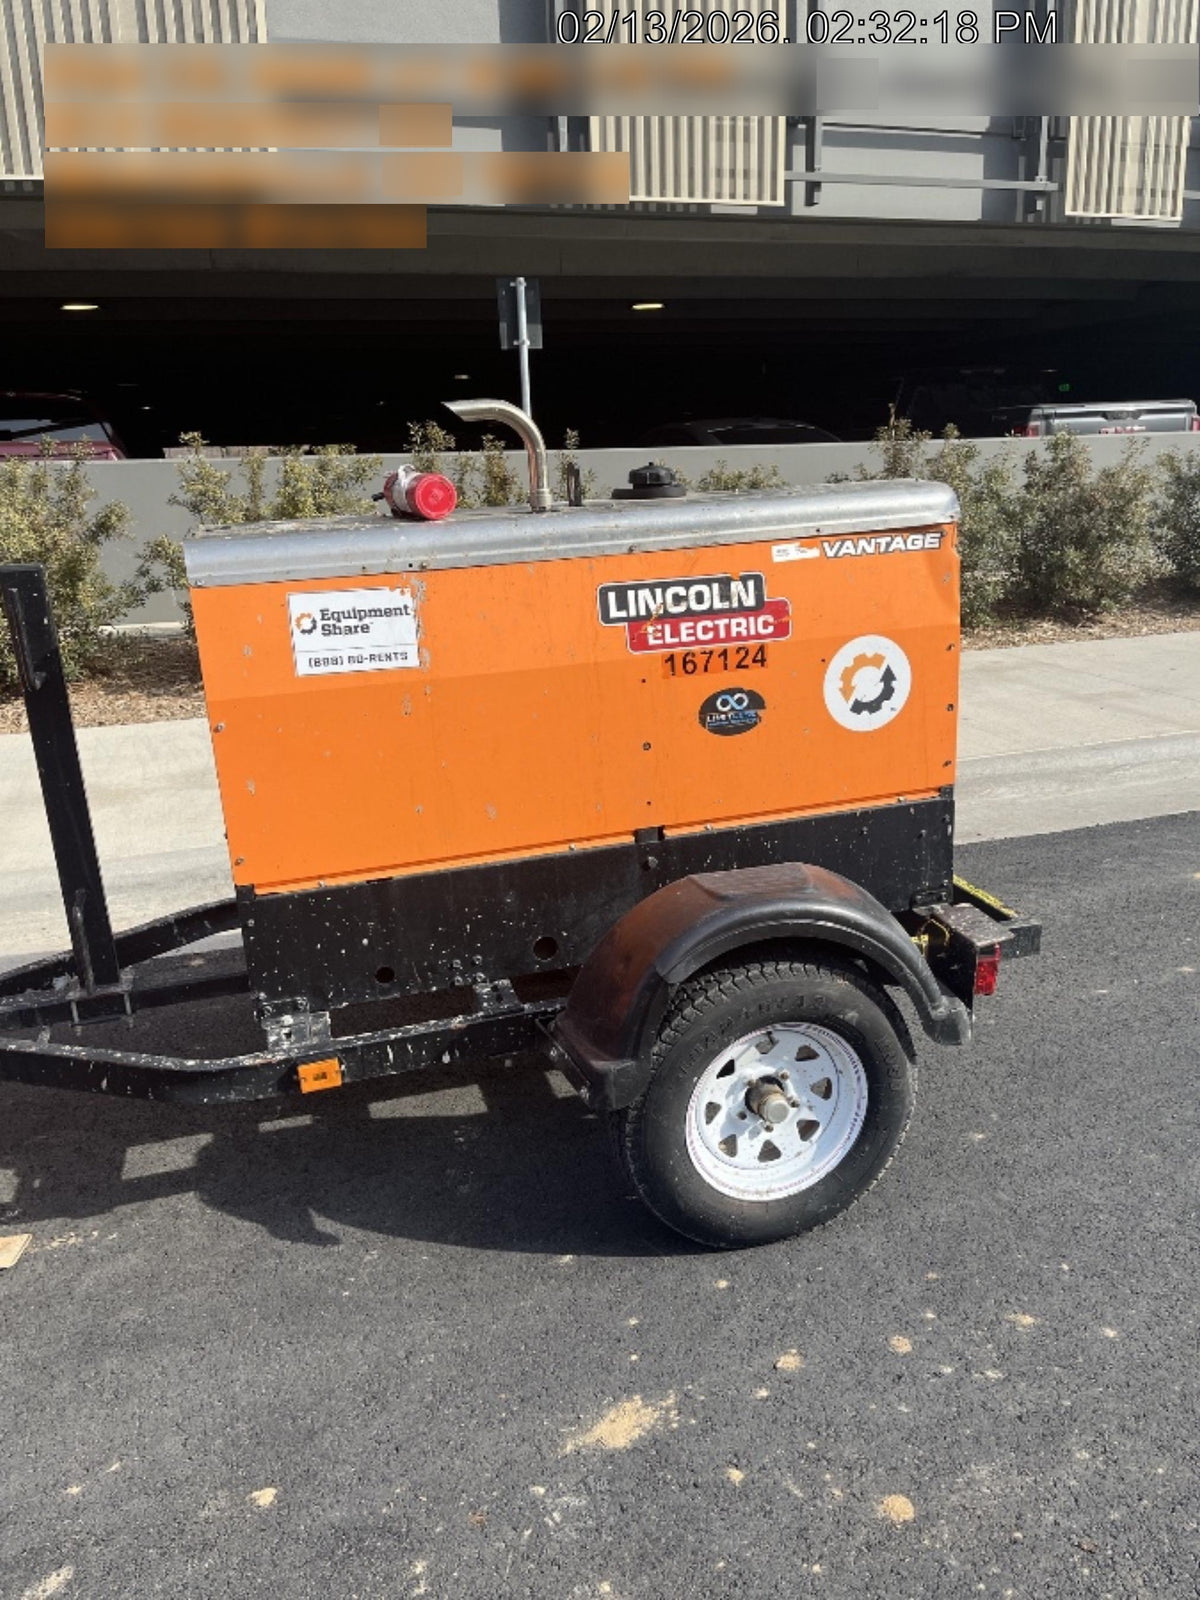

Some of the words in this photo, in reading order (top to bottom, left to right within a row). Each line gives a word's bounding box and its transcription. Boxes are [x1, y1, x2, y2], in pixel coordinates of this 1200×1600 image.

[822, 532, 942, 559] VANTAGE
[319, 604, 411, 623] Equipment
[608, 579, 757, 619] LINCOLN
[321, 623, 370, 637] Share
[647, 614, 775, 646] ELECTRIC
[664, 644, 768, 676] 167124
